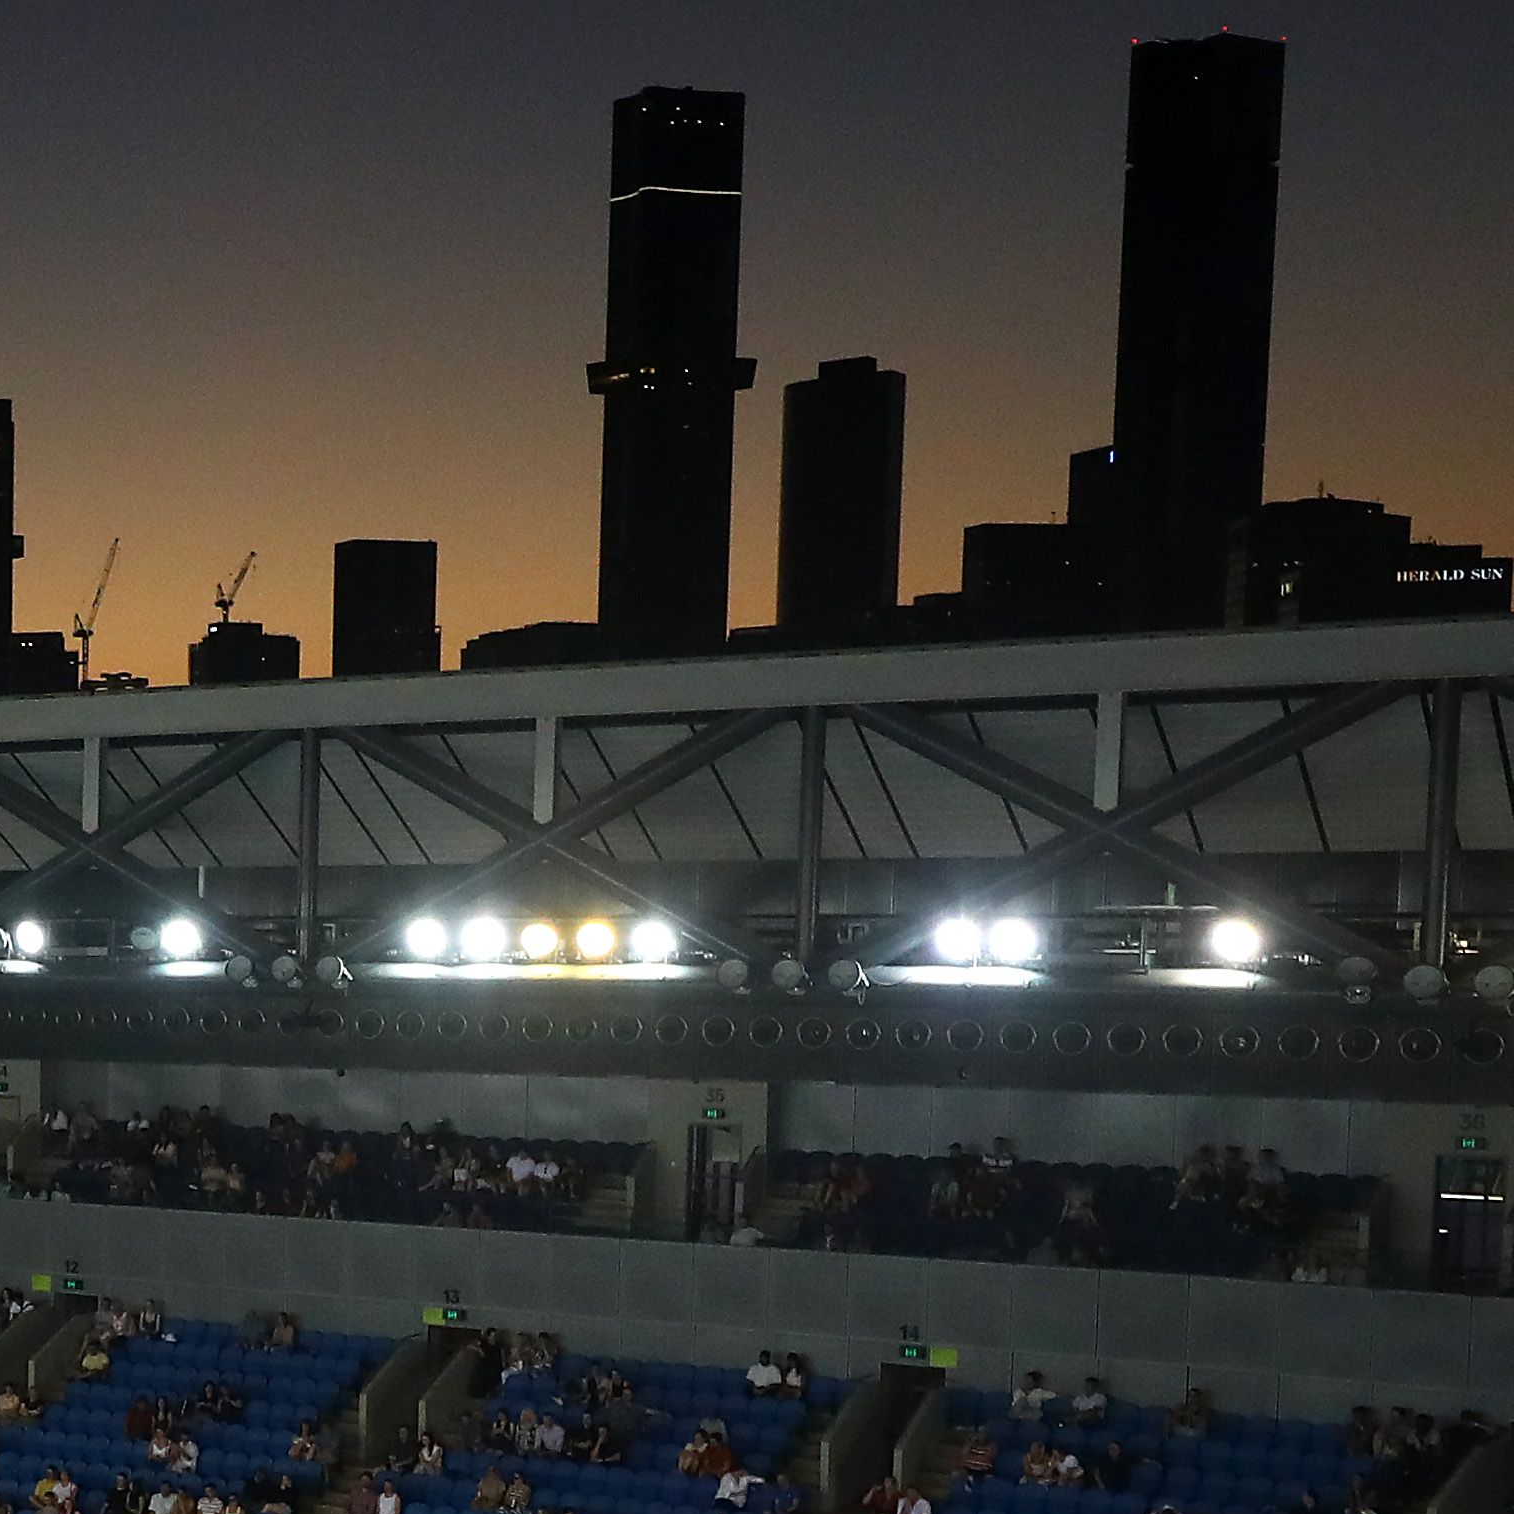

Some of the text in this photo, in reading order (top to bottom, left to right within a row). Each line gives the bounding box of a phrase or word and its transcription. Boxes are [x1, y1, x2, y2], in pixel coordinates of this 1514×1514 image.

[1397, 568, 1503, 582] HERALD SUN
[65, 1260, 79, 1273] 12
[444, 1289, 460, 1304] 13
